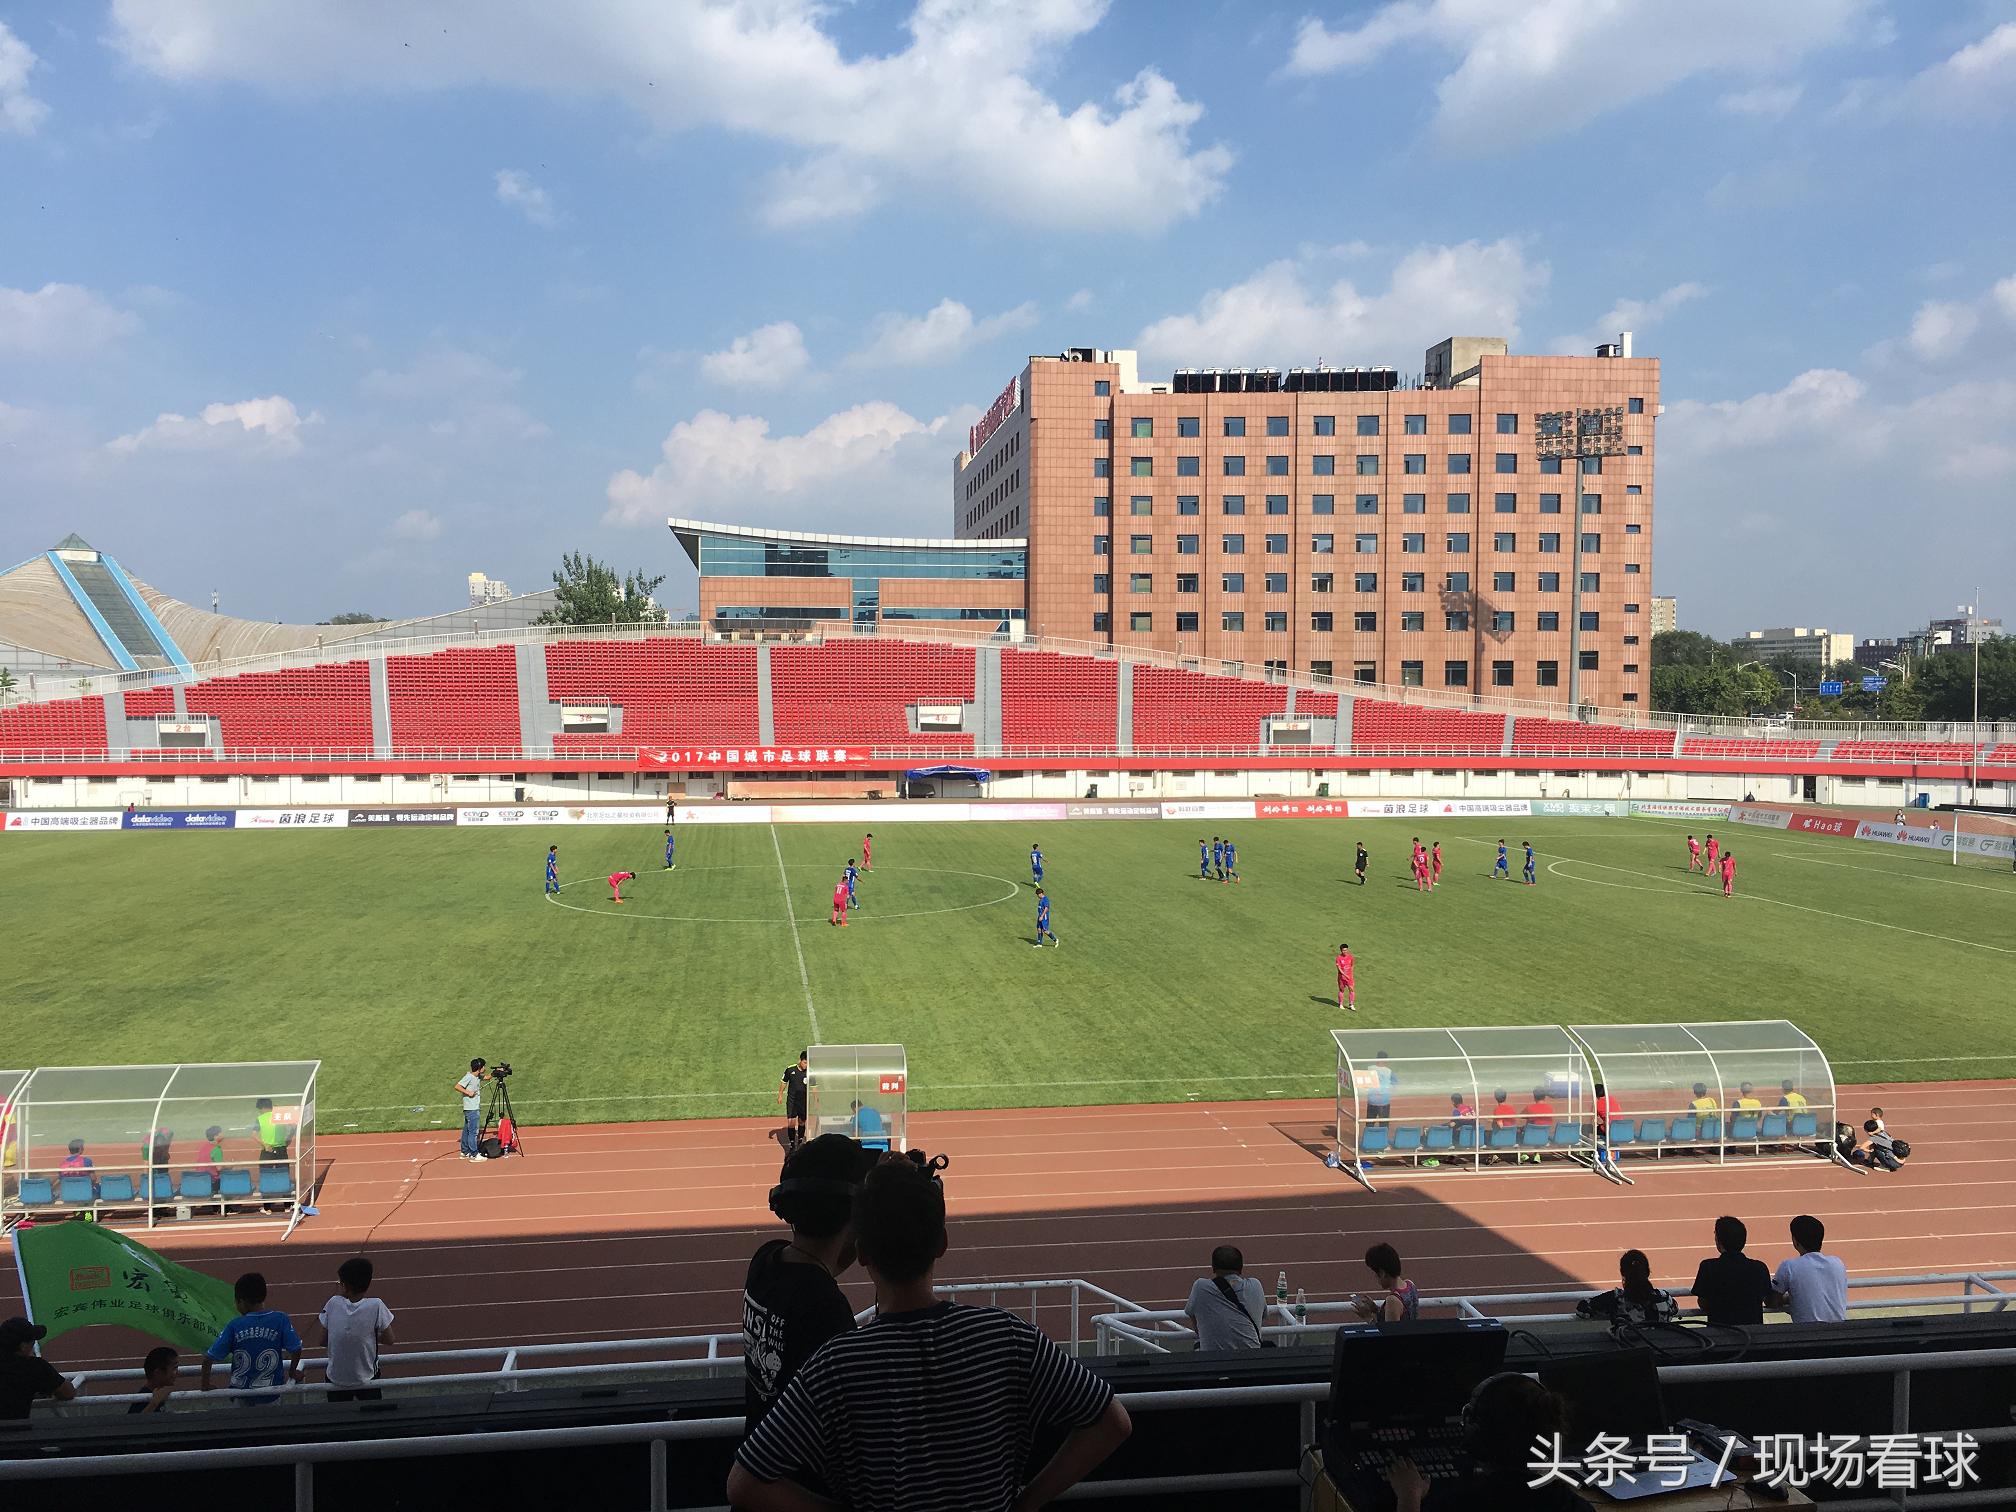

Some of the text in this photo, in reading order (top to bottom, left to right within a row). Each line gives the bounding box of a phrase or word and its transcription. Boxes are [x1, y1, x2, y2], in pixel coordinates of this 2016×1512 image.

[176, 725, 191, 733] 2台
[659, 749, 847, 763] 2017中国城市足球联赛
[1383, 804, 1429, 814] 茵浪足球
[31, 816, 119, 826] 中国高端吸尘器品牌
[131, 814, 174, 823] datavideo
[185, 814, 228, 823] datavideo
[279, 813, 335, 824] 茵浪足球
[1872, 830, 1893, 838] HUAWEI
[1908, 834, 1930, 843] HUAWEI
[771, 1314, 785, 1328] OFF
[769, 1325, 783, 1339] THE
[767, 1336, 784, 1352] WALL
[230, 1348, 280, 1388] 22
